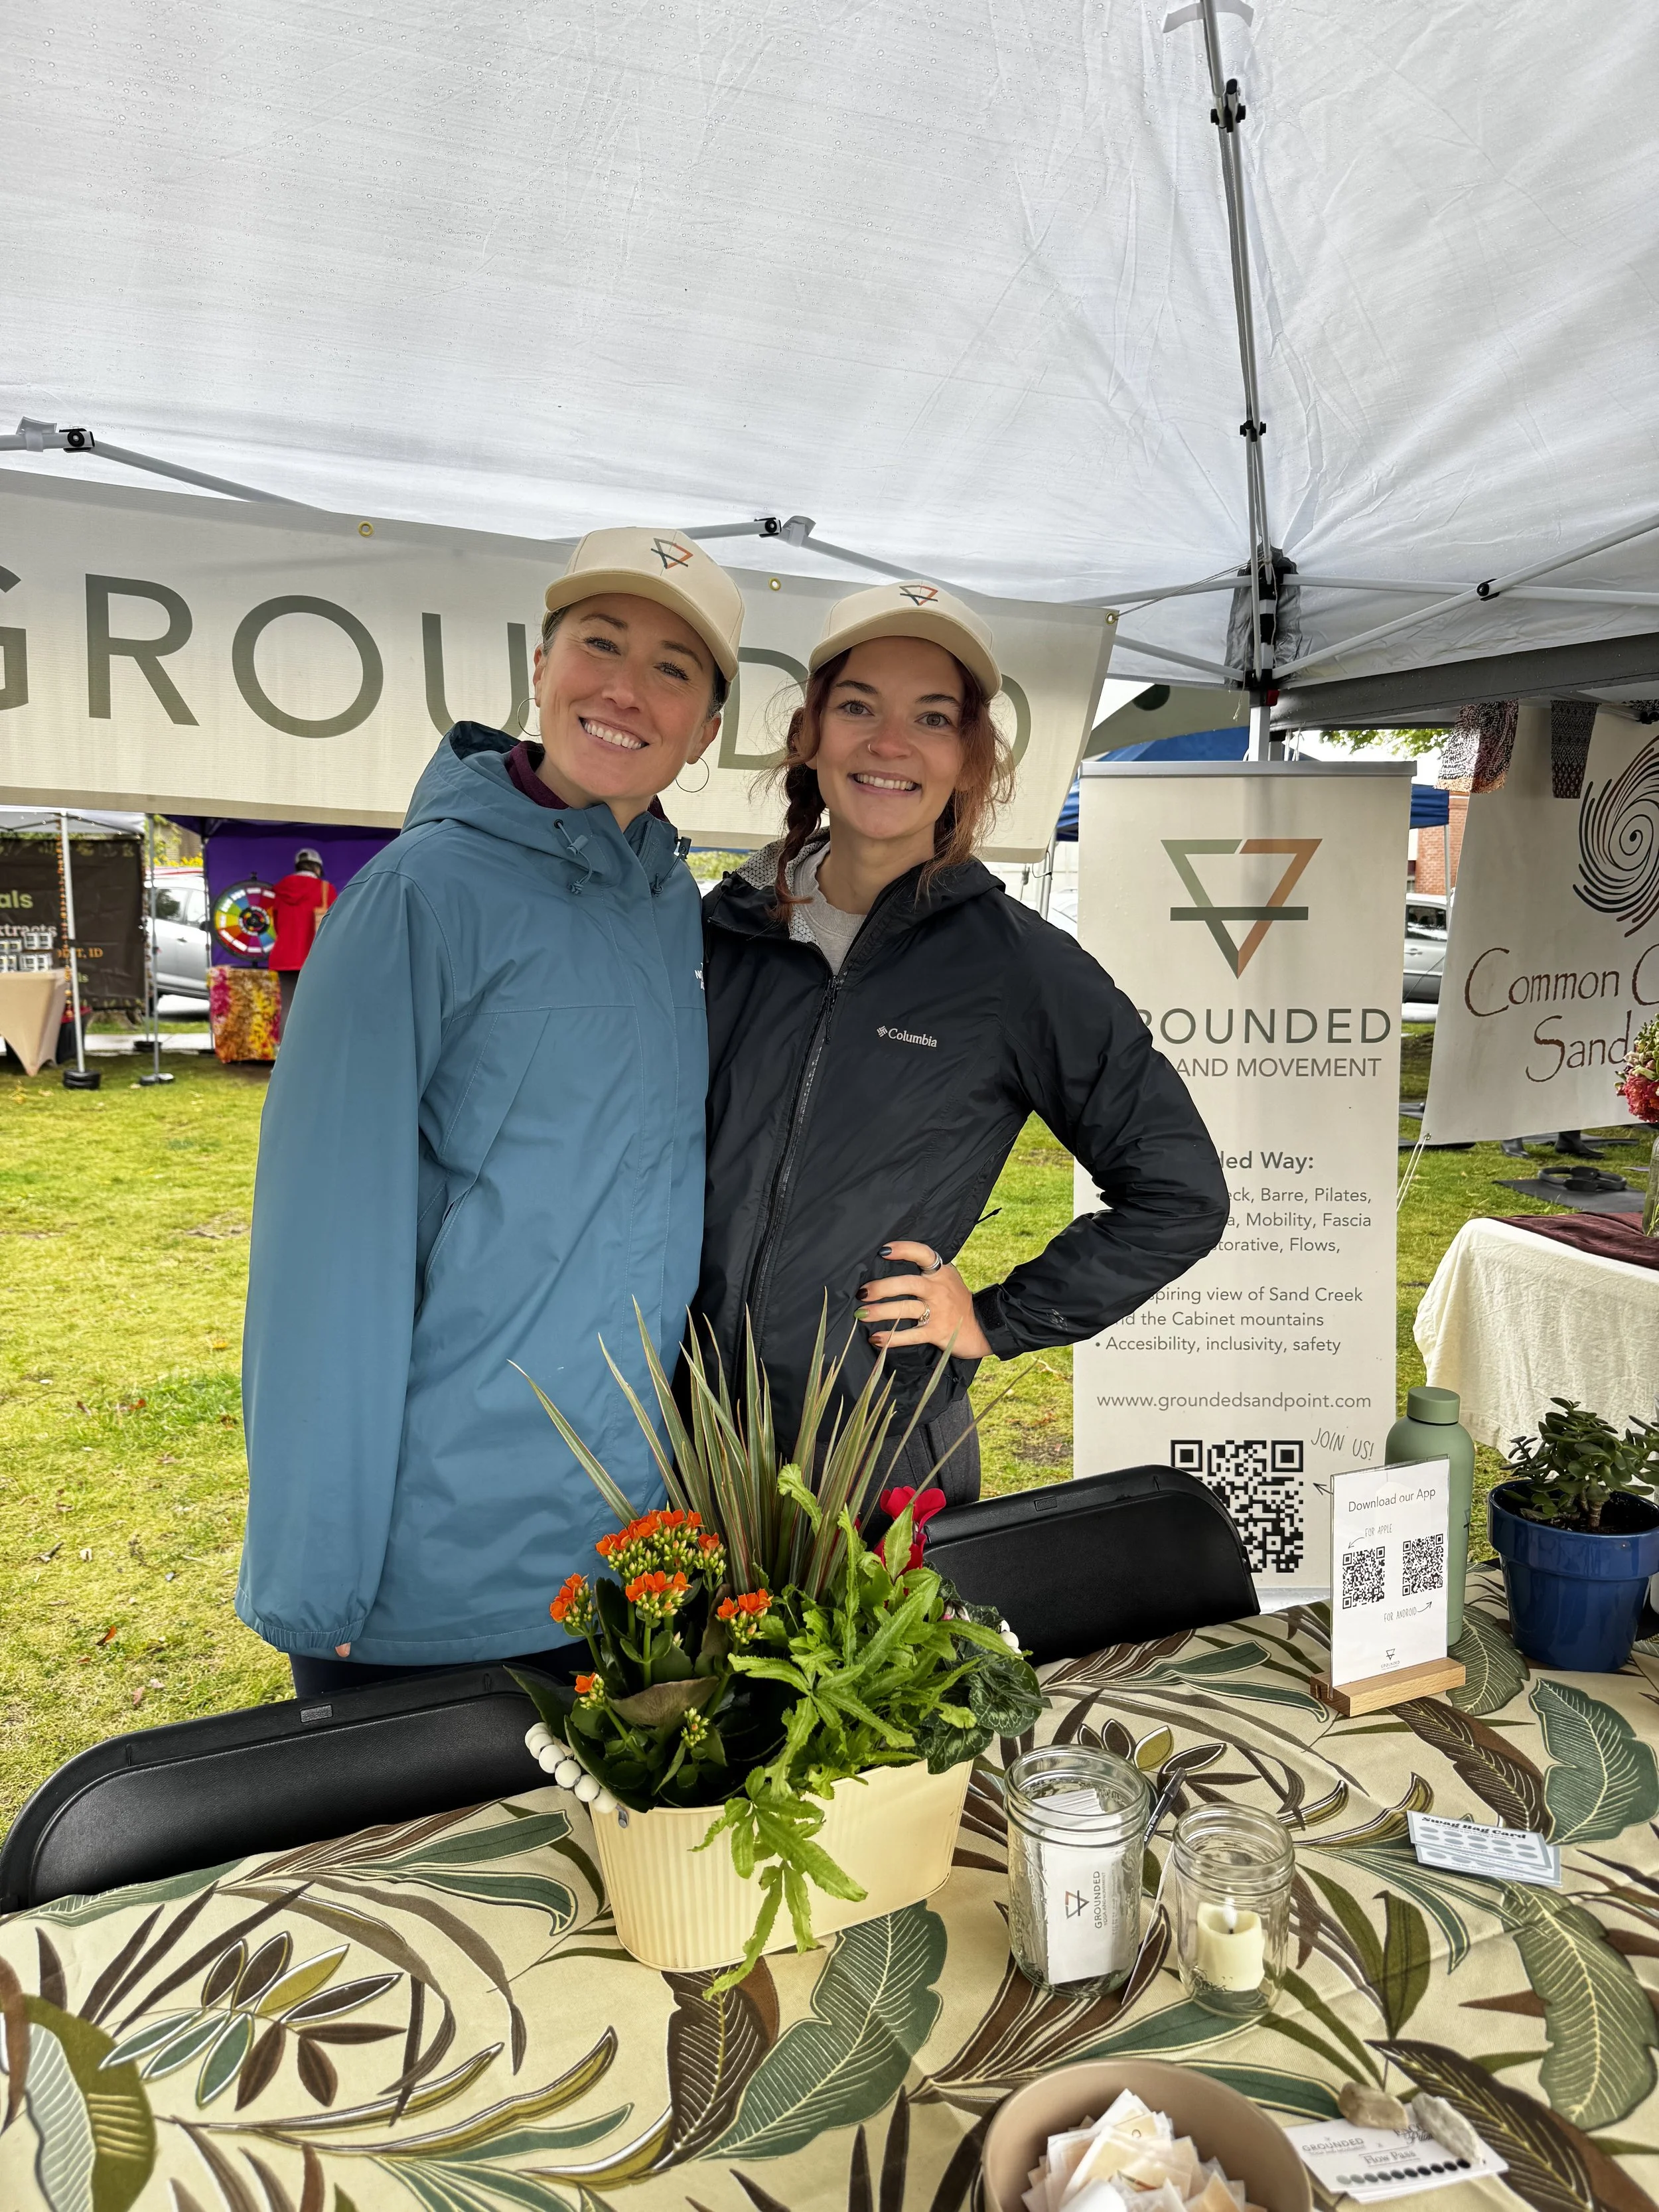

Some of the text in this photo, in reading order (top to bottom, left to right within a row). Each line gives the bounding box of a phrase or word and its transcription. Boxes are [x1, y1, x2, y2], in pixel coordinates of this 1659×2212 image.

[1465, 947, 1620, 1017] Common
[888, 1028, 938, 1048] Columbia
[1526, 1010, 1638, 1083] Sand
[1176, 1058, 1382, 1078] AND MOVEMENT
[1260, 1151, 1314, 1175] Way:
[1261, 1187, 1308, 1204] Barre,
[1315, 1187, 1372, 1204] Pilates,
[1246, 1212, 1316, 1230] Mobility,
[1323, 1213, 1372, 1227] Fascia
[1289, 1237, 1340, 1254] Flows,
[1206, 1287, 1243, 1301] view
[1248, 1285, 1265, 1301] of
[1269, 1286, 1309, 1302] Sand
[1315, 1286, 1363, 1302] Creek
[1141, 1311, 1167, 1325] the
[1172, 1311, 1236, 1326] Cabinet
[1240, 1312, 1325, 1327] mountains
[1106, 1335, 1341, 1355] Accesibility, inclusivity, safety
[1097, 1391, 1372, 1412] wwww.groundedsandpoint.com
[1311, 1428, 1374, 1461] JOIN US!
[1348, 1488, 1436, 1512] Download our App
[1365, 1523, 1393, 1537] FOR APPLE
[1384, 1606, 1417, 1623] FOR ANDROID
[1421, 1816, 1460, 1829] Swag
[1462, 1822, 1490, 1834] Bag
[1492, 1829, 1526, 1839] Card
[1093, 1871, 1102, 1929] GROUNDED
[1301, 2137, 1364, 2152] GROUNDED
[1364, 2150, 1417, 2164] Flow Pass
